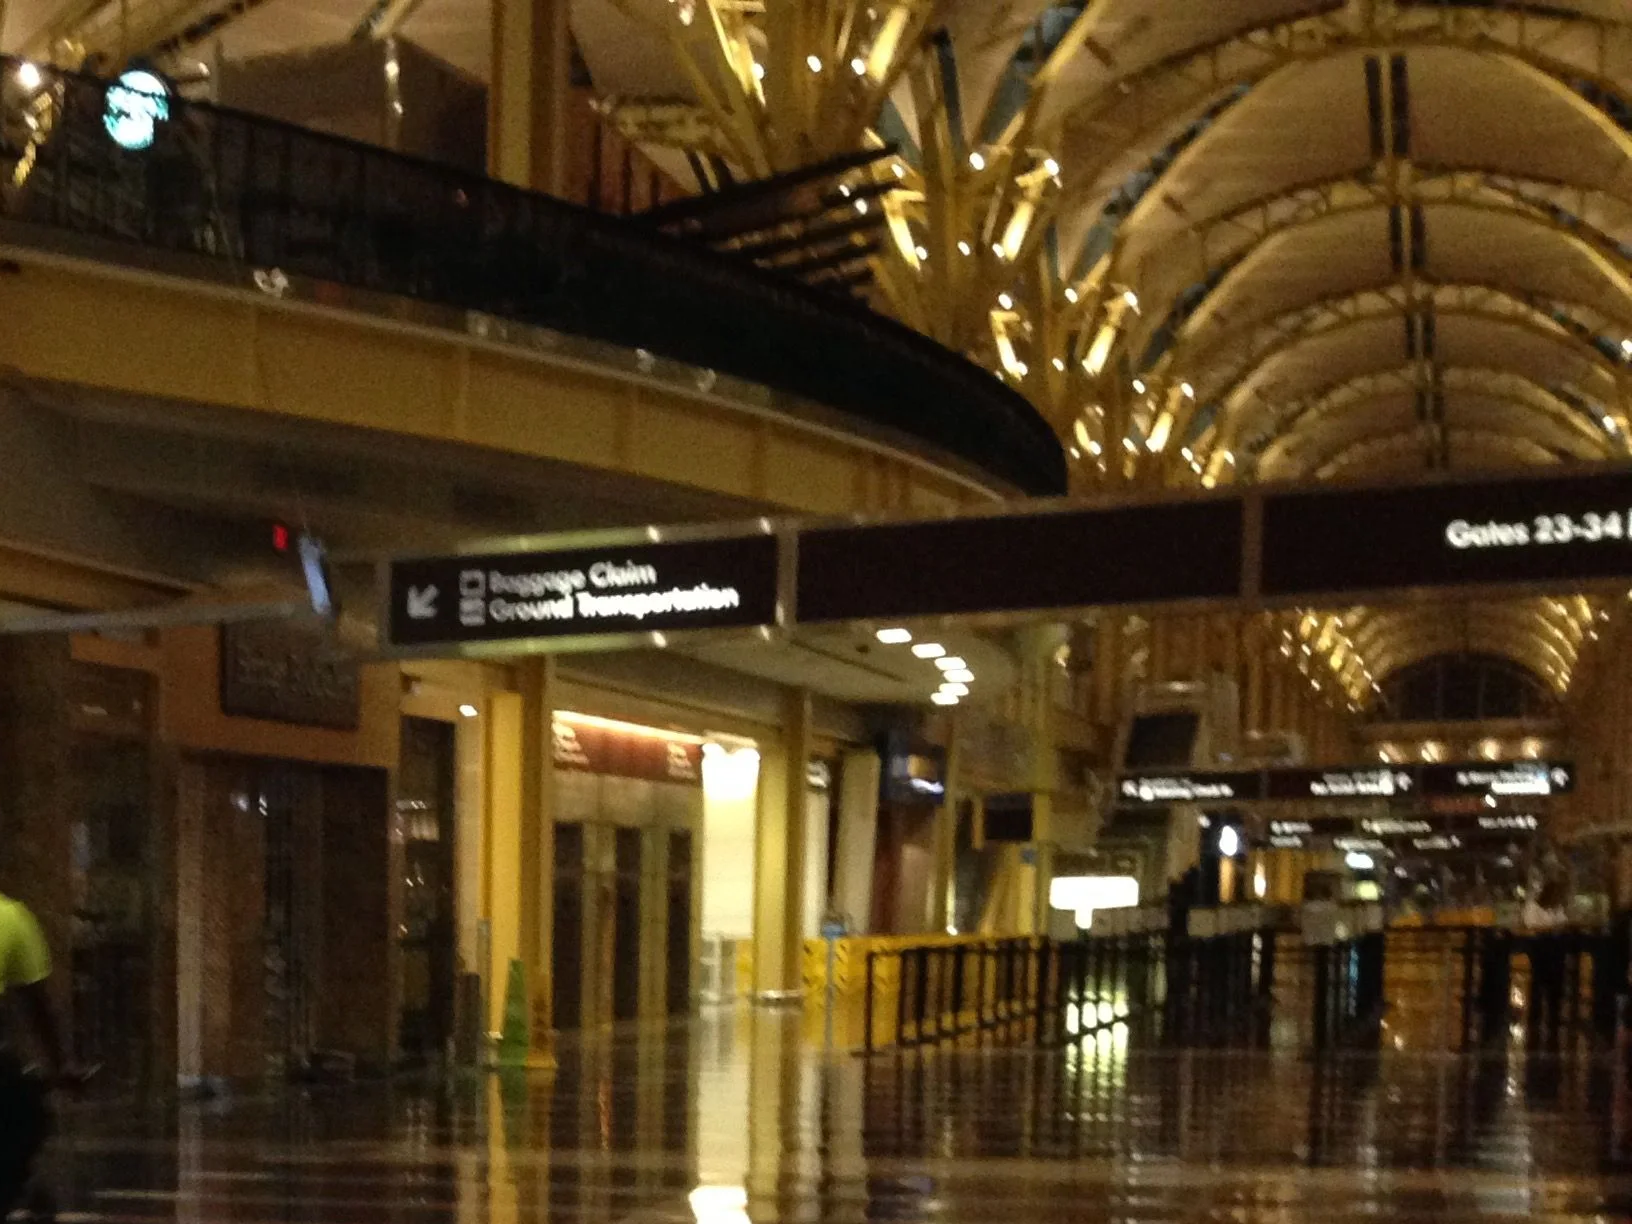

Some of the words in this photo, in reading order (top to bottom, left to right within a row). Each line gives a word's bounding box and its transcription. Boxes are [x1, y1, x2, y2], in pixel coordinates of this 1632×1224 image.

[1445, 518, 1530, 548] Gates
[1533, 511, 1623, 543] 23-34
[488, 569, 586, 597] Baggage
[588, 560, 658, 588] Claim
[489, 596, 574, 622] Ground
[575, 583, 739, 619] Transportation
